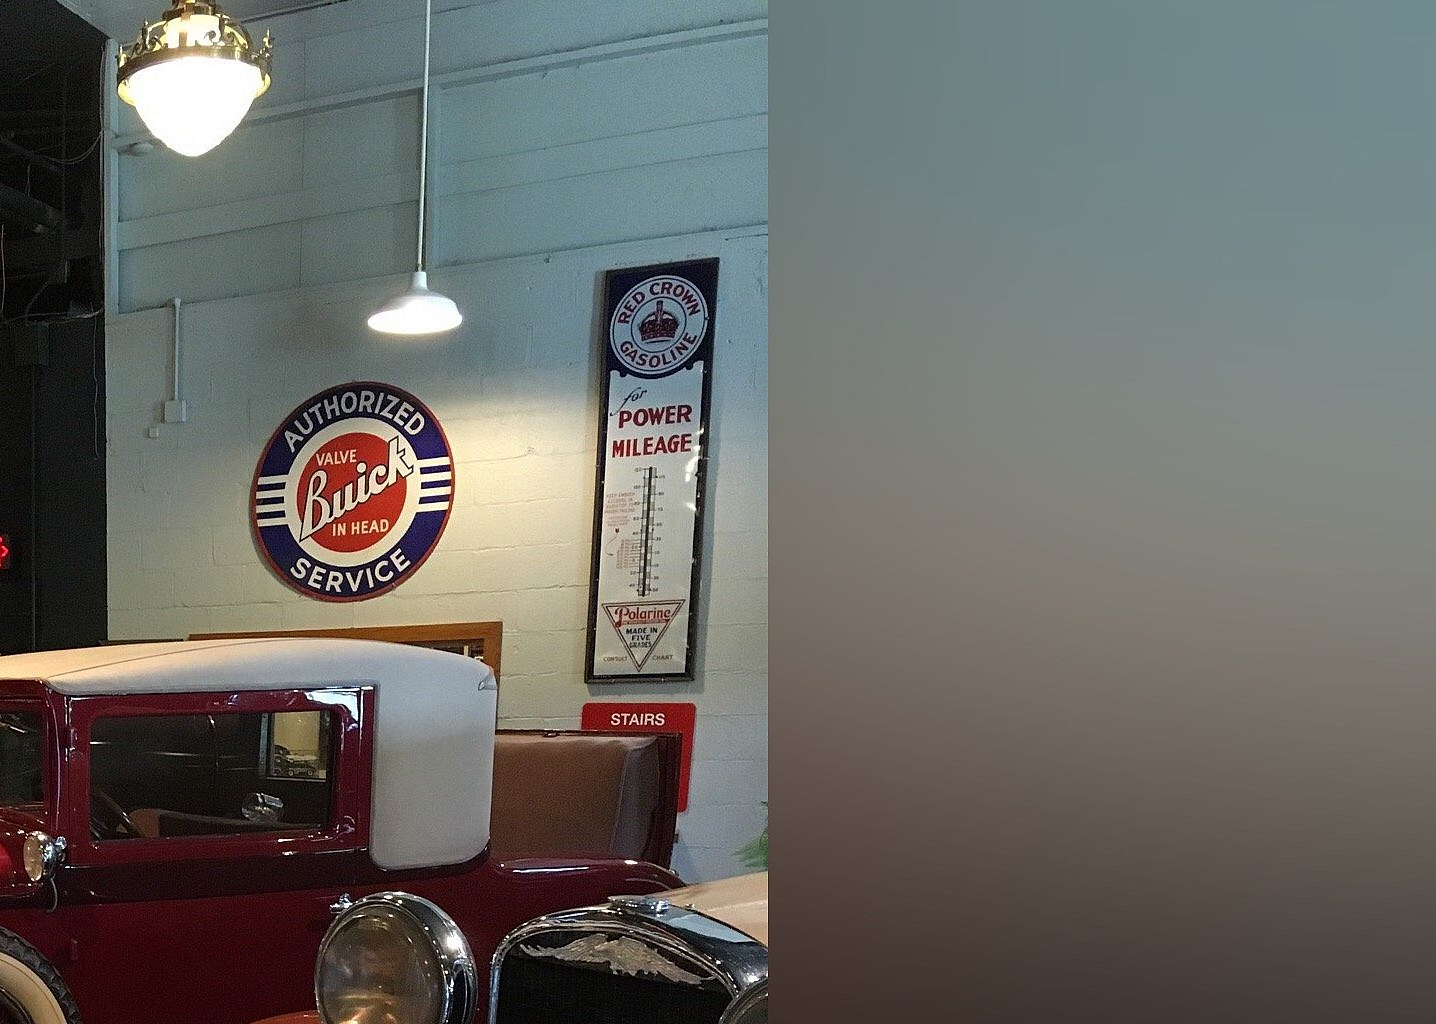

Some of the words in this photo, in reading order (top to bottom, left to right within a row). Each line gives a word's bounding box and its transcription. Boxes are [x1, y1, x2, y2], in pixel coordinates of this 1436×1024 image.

[617, 291, 646, 325] RED
[649, 281, 701, 316] CROWN
[619, 332, 698, 368] GASOLINE
[610, 387, 648, 417] for
[283, 390, 426, 453] AUTHORIZED
[618, 404, 693, 429] POWER
[316, 449, 357, 466] VALVE
[612, 433, 693, 458] MILEAGE
[299, 436, 415, 542] Buick
[332, 521, 347, 537] IN
[351, 518, 390, 535] HEAD
[290, 547, 412, 593] SERVICE
[614, 606, 671, 628] Polarine
[626, 627, 647, 635] MADE
[650, 626, 658, 634] IN
[610, 712, 666, 726] STAIRS
